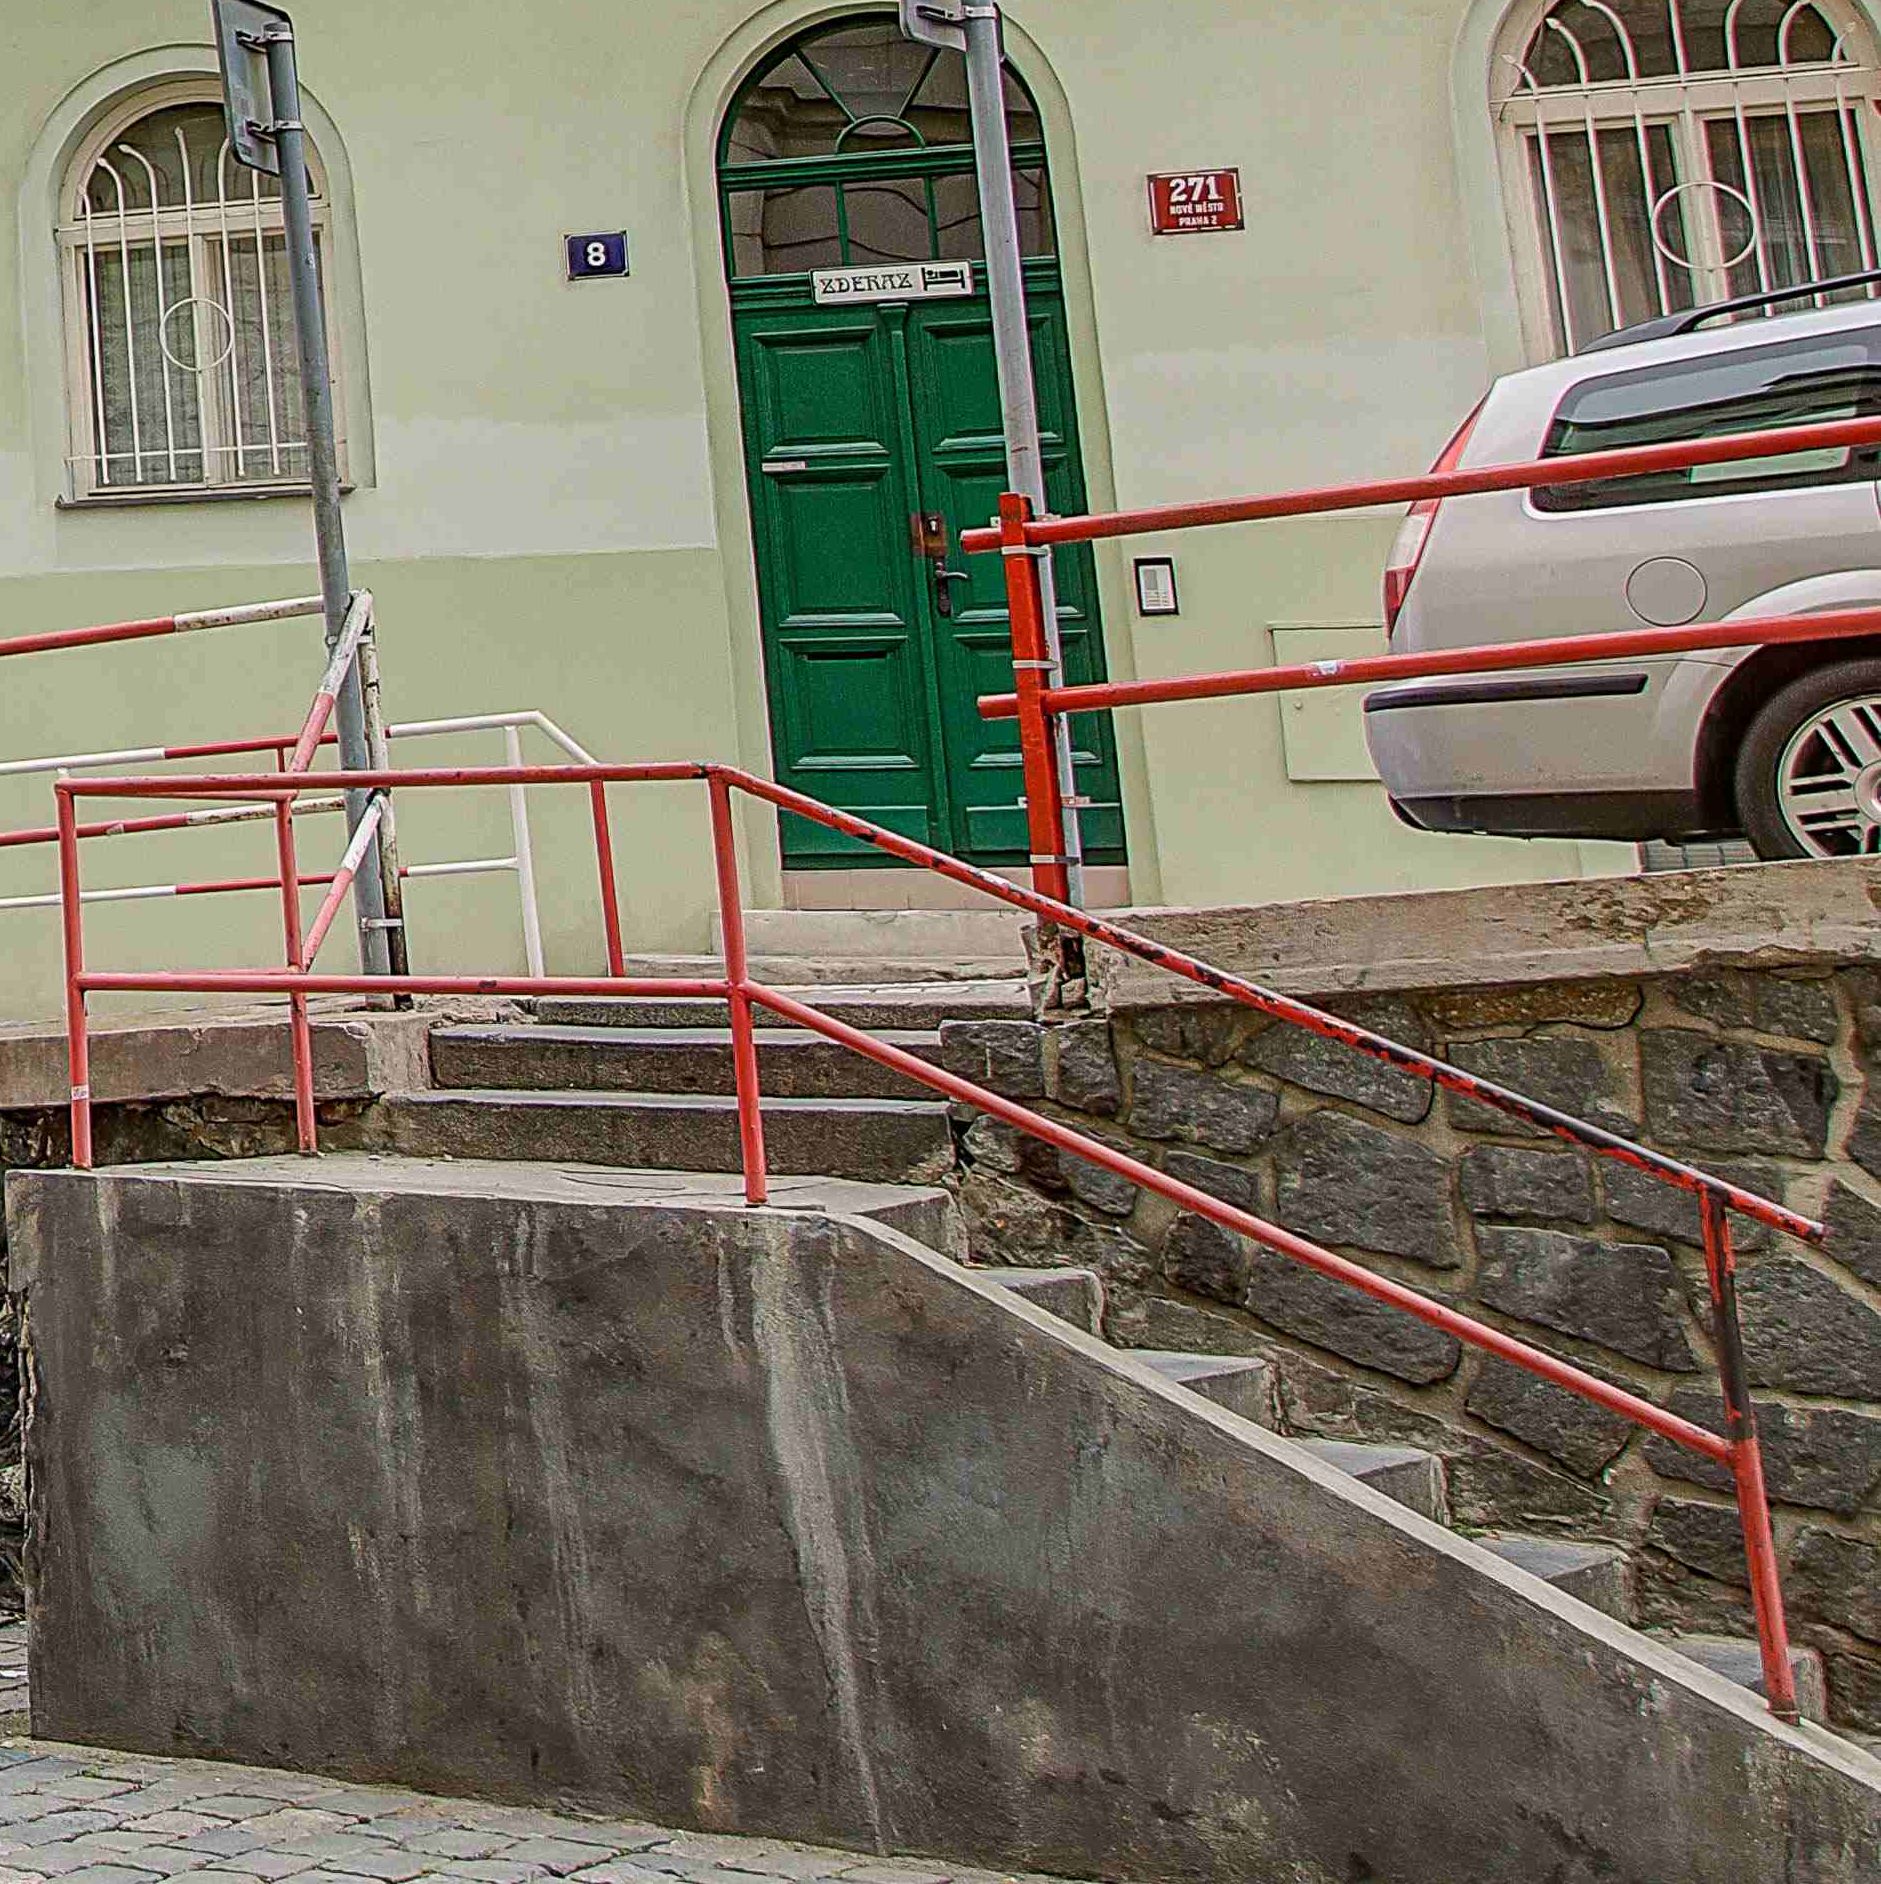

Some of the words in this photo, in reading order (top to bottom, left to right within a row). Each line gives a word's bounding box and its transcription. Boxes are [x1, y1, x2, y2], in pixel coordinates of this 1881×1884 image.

[1169, 176, 1225, 202] 271
[1179, 216, 1208, 227] PRAHA
[587, 242, 606, 267] 8
[820, 273, 913, 294] ZDERAZ
